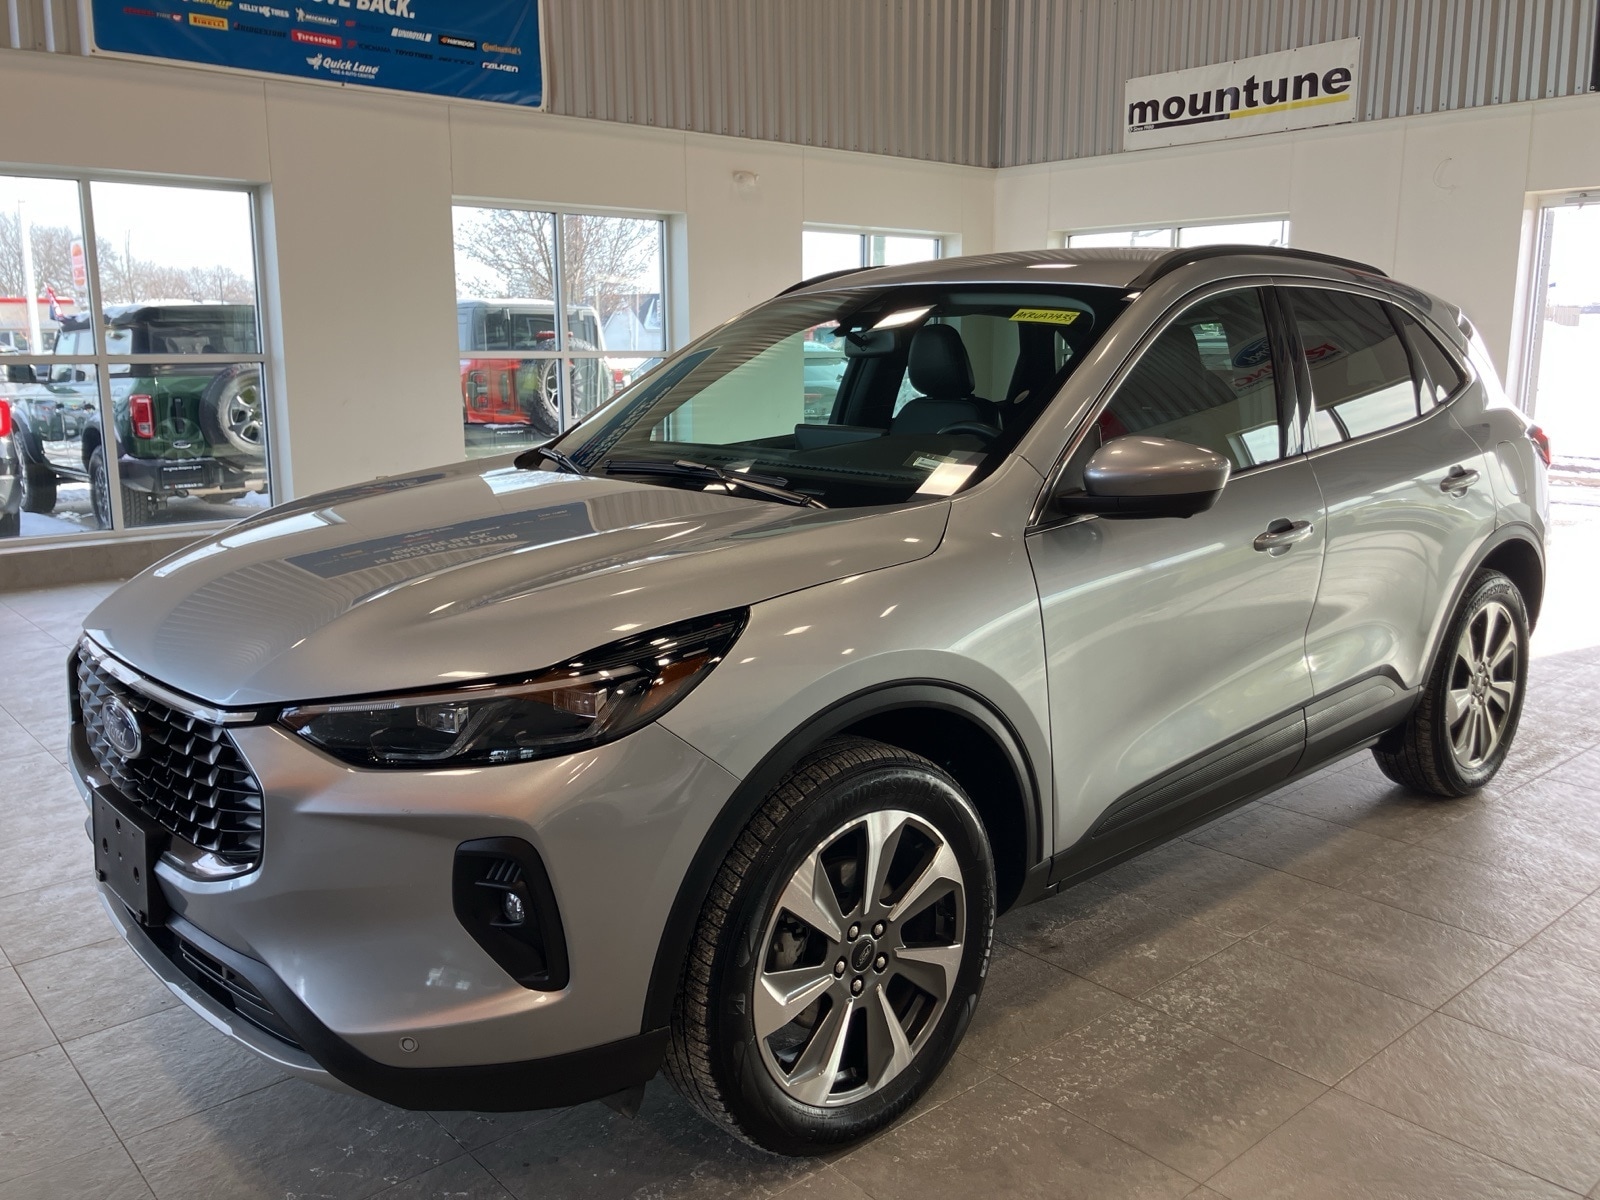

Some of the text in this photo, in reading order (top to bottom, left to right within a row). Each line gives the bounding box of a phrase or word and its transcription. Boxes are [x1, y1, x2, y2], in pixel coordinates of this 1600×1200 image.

[238, 3, 259, 12] KELLY
[270, 8, 290, 18] TIRES
[192, 16, 226, 28] PIRELLI
[305, 13, 338, 25] MICHELIN
[296, 32, 338, 46] Firestone
[322, 57, 380, 74] Quick Lane
[482, 61, 519, 73] FALKEN
[1128, 67, 1352, 125] mountune
